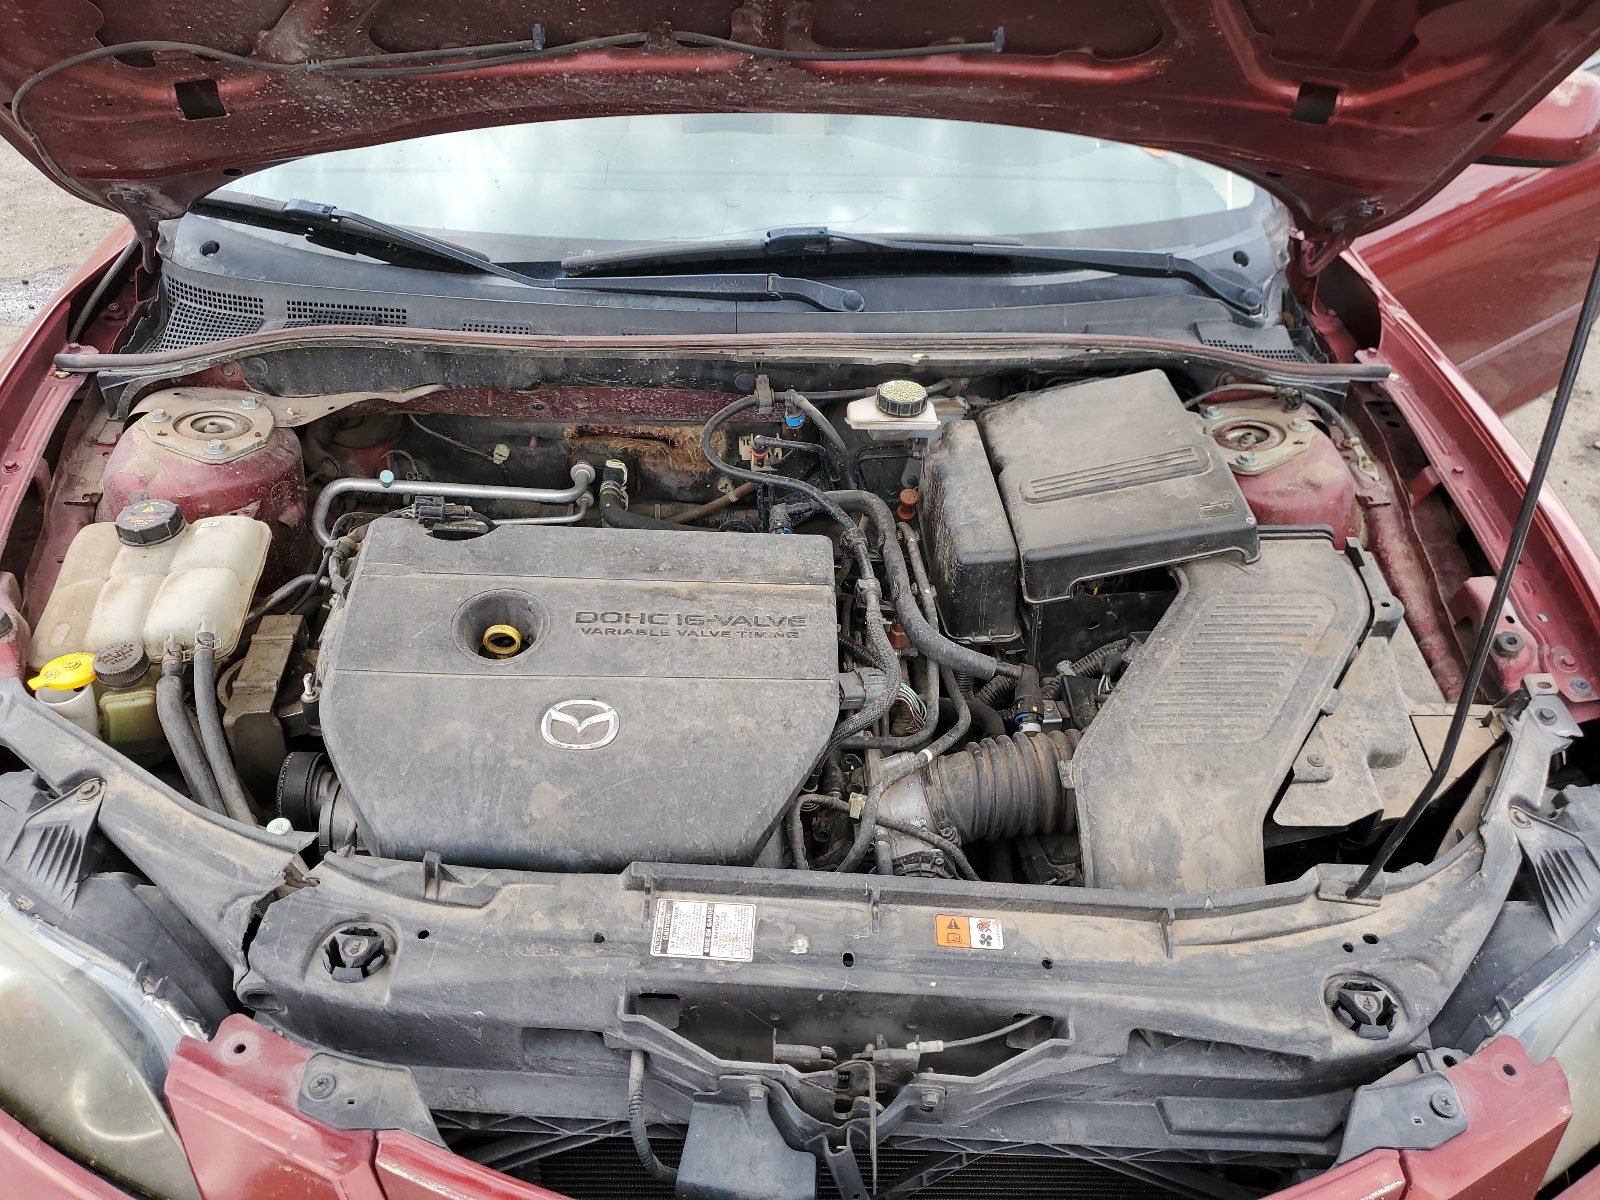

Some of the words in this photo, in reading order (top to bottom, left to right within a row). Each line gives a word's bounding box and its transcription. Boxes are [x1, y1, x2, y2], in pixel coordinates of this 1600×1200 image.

[575, 611, 669, 625] DOHC
[580, 627, 671, 637] VARIABLE
[677, 629, 732, 638] VALVE
[736, 630, 799, 639] TIMING
[706, 906, 714, 927] GARDE
[662, 913, 671, 940] CAUTION
